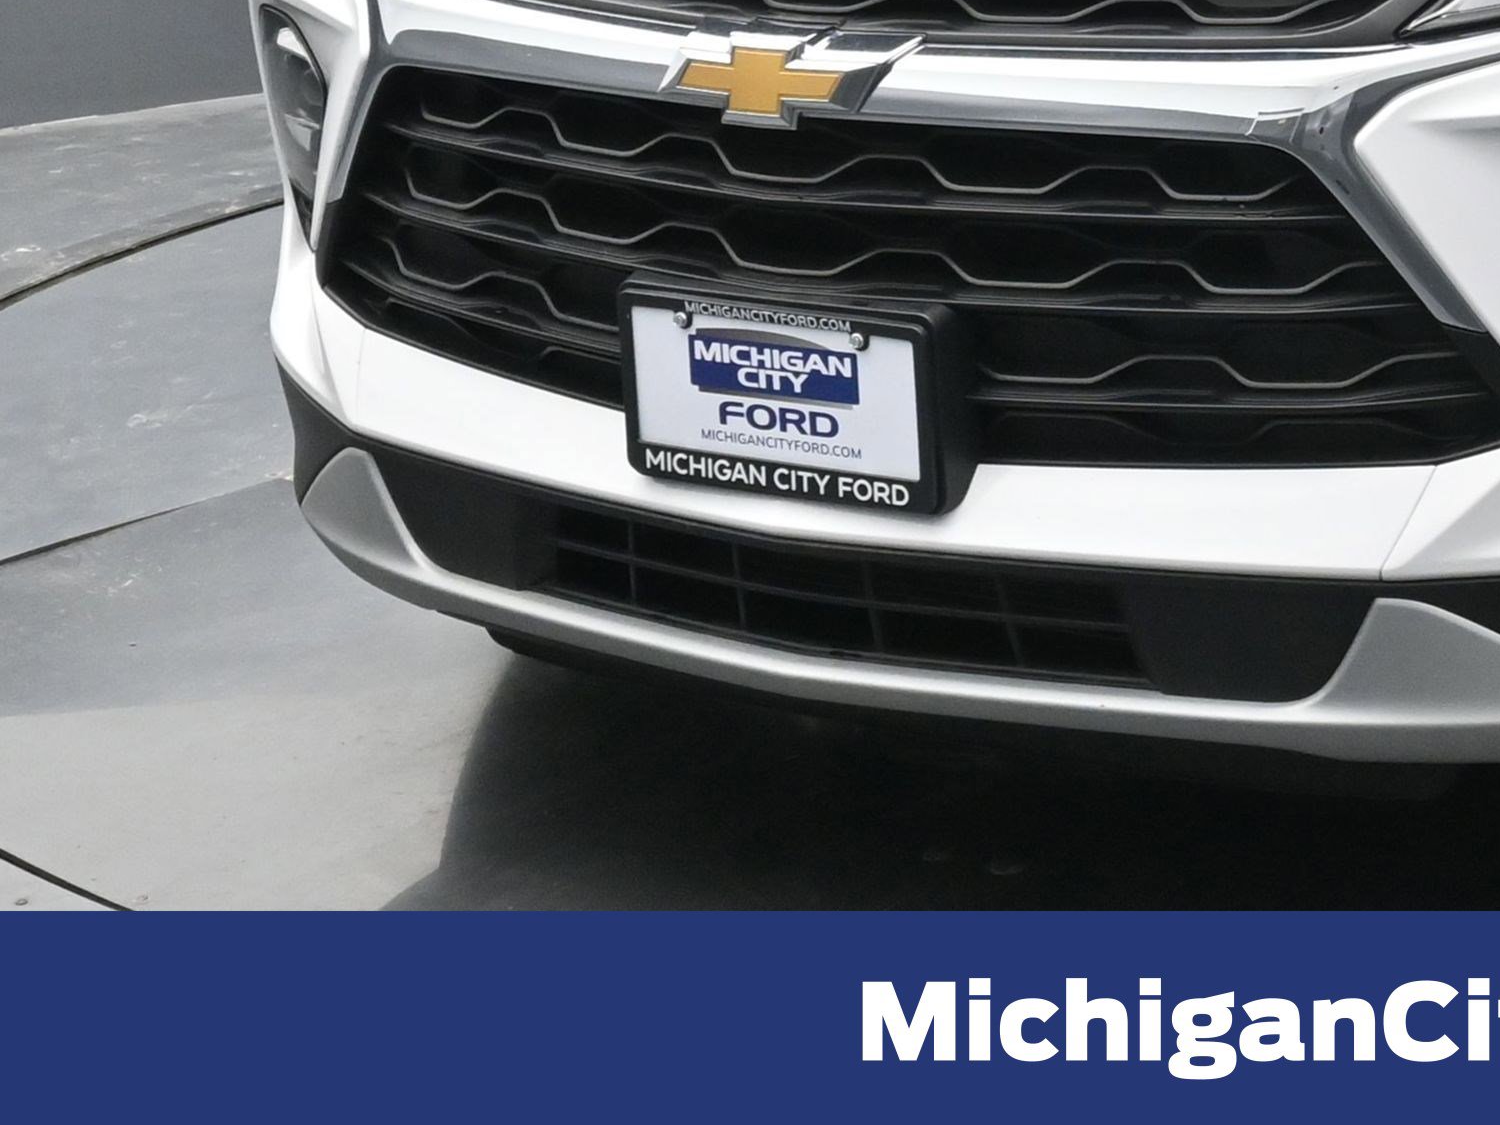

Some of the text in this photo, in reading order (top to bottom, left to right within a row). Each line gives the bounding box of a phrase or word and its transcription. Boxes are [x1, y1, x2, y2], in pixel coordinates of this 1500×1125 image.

[684, 301, 851, 332] MICHIGANCITYFORD.COM
[694, 340, 852, 378] MICHIGAN
[737, 369, 809, 393] CITY
[718, 401, 839, 438] FORD
[701, 428, 862, 459] MICHIGANCITYFORD.COM
[645, 448, 910, 507] MICHIGAN CITY FORD
